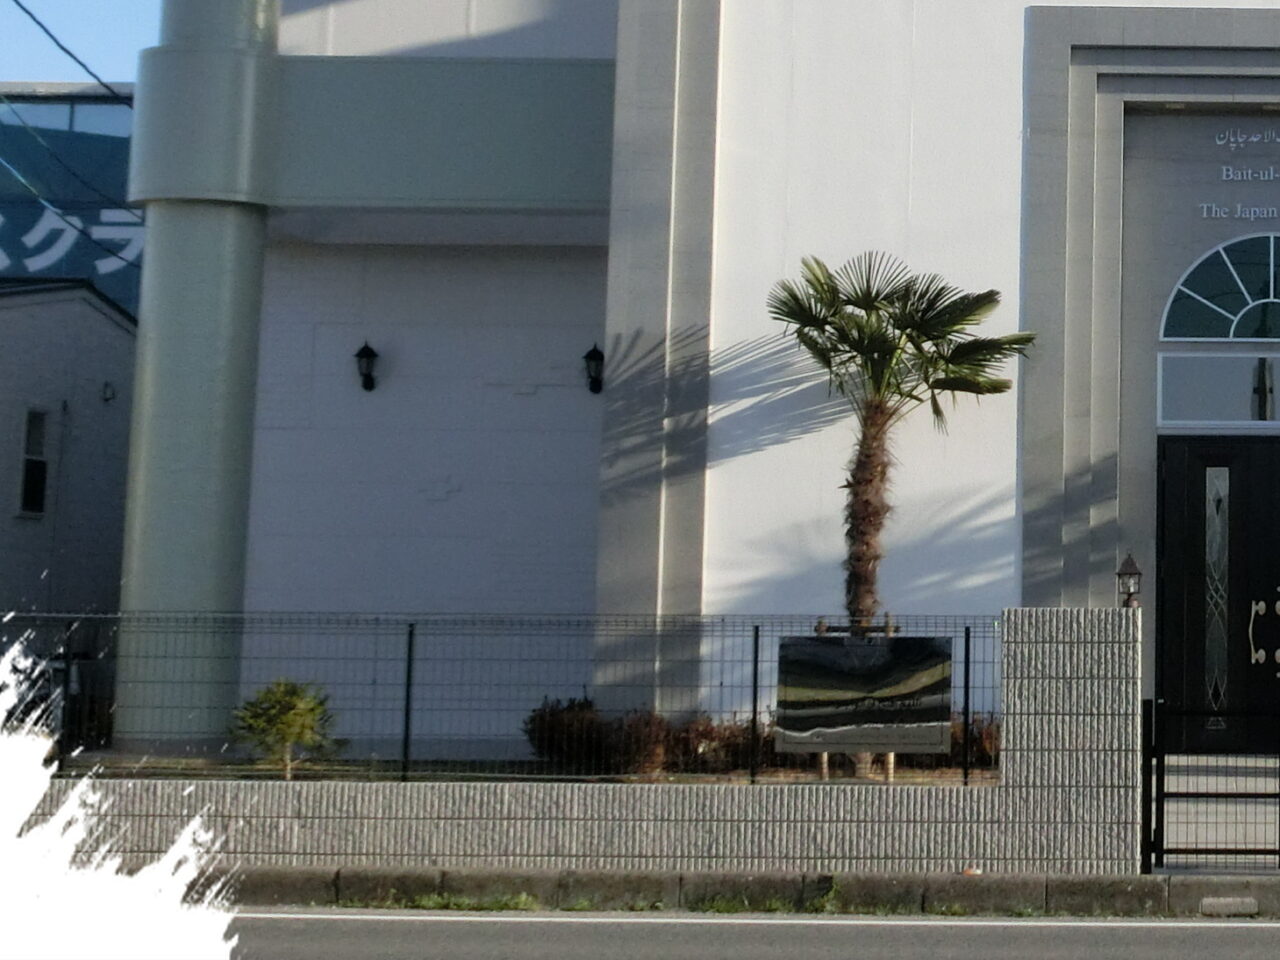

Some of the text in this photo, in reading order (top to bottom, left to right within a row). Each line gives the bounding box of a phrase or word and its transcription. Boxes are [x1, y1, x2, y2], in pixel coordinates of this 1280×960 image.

[1199, 203, 1229, 219] The
[1234, 204, 1278, 222] Japan
[0, 207, 147, 275] クラ
